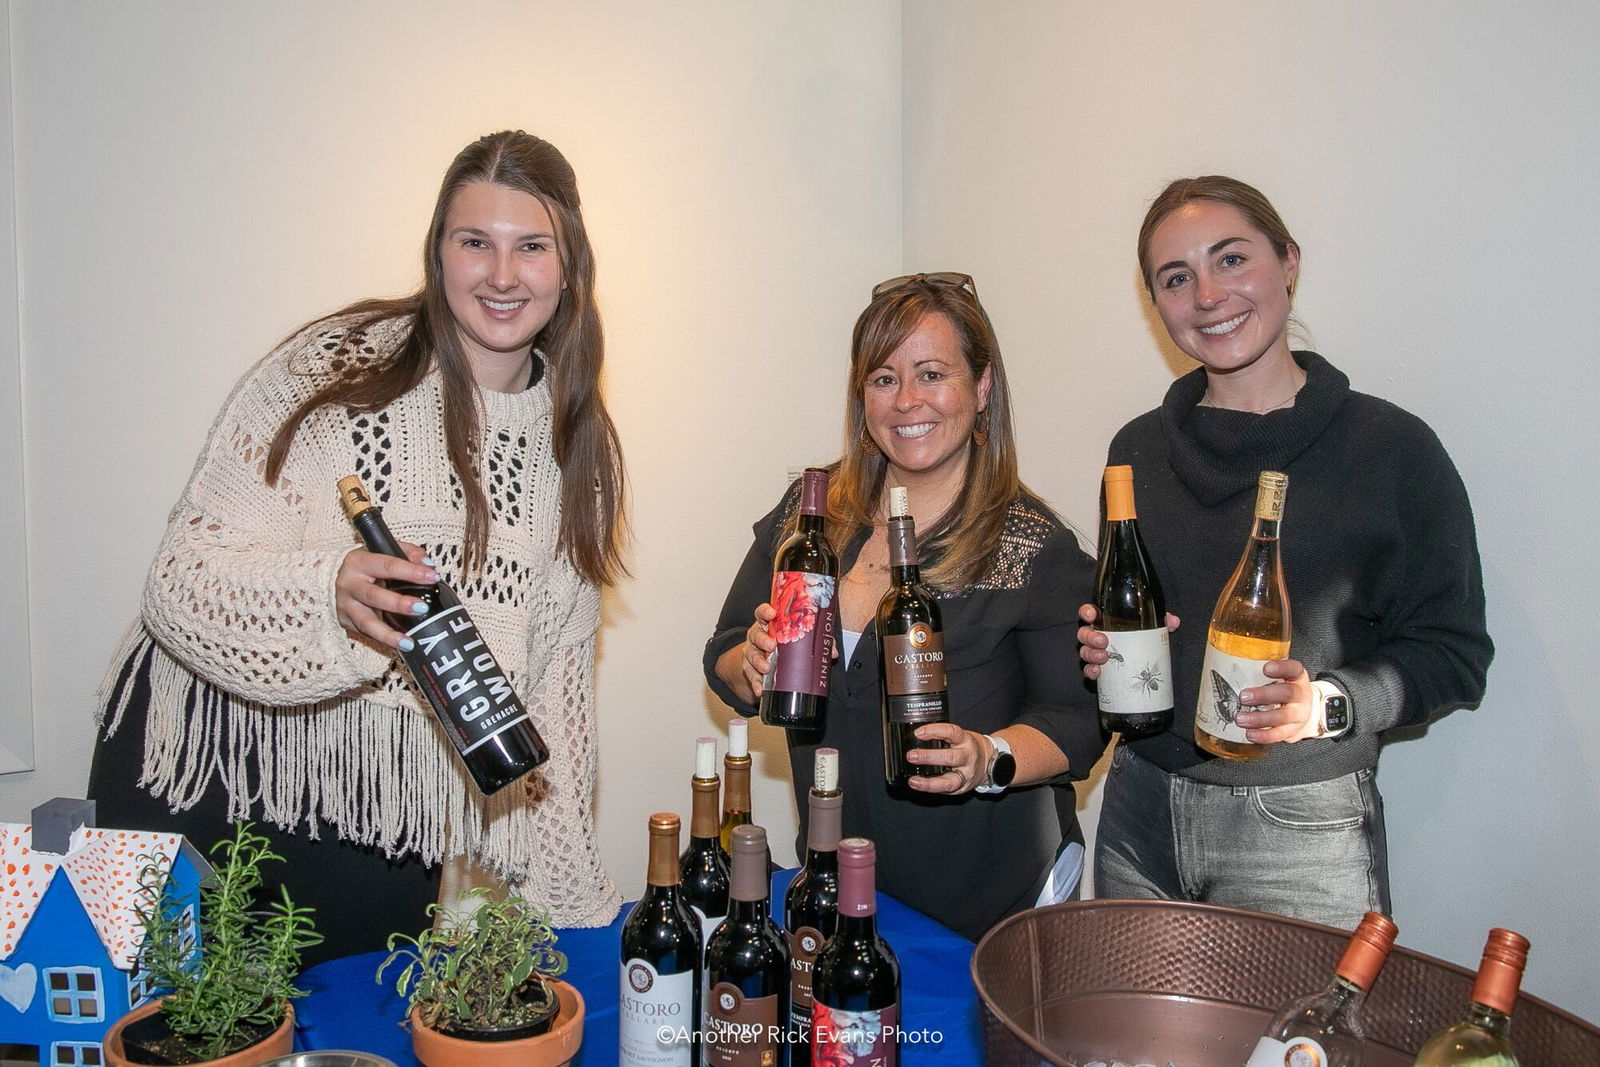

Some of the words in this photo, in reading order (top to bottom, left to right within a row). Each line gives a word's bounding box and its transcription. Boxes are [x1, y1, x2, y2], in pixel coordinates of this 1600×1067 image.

[449, 616, 513, 706] WOLF
[894, 651, 944, 665] CASTORO
[418, 630, 491, 722] GREY
[480, 704, 519, 730] GRENACHE
[621, 993, 681, 1016] ASTORO
